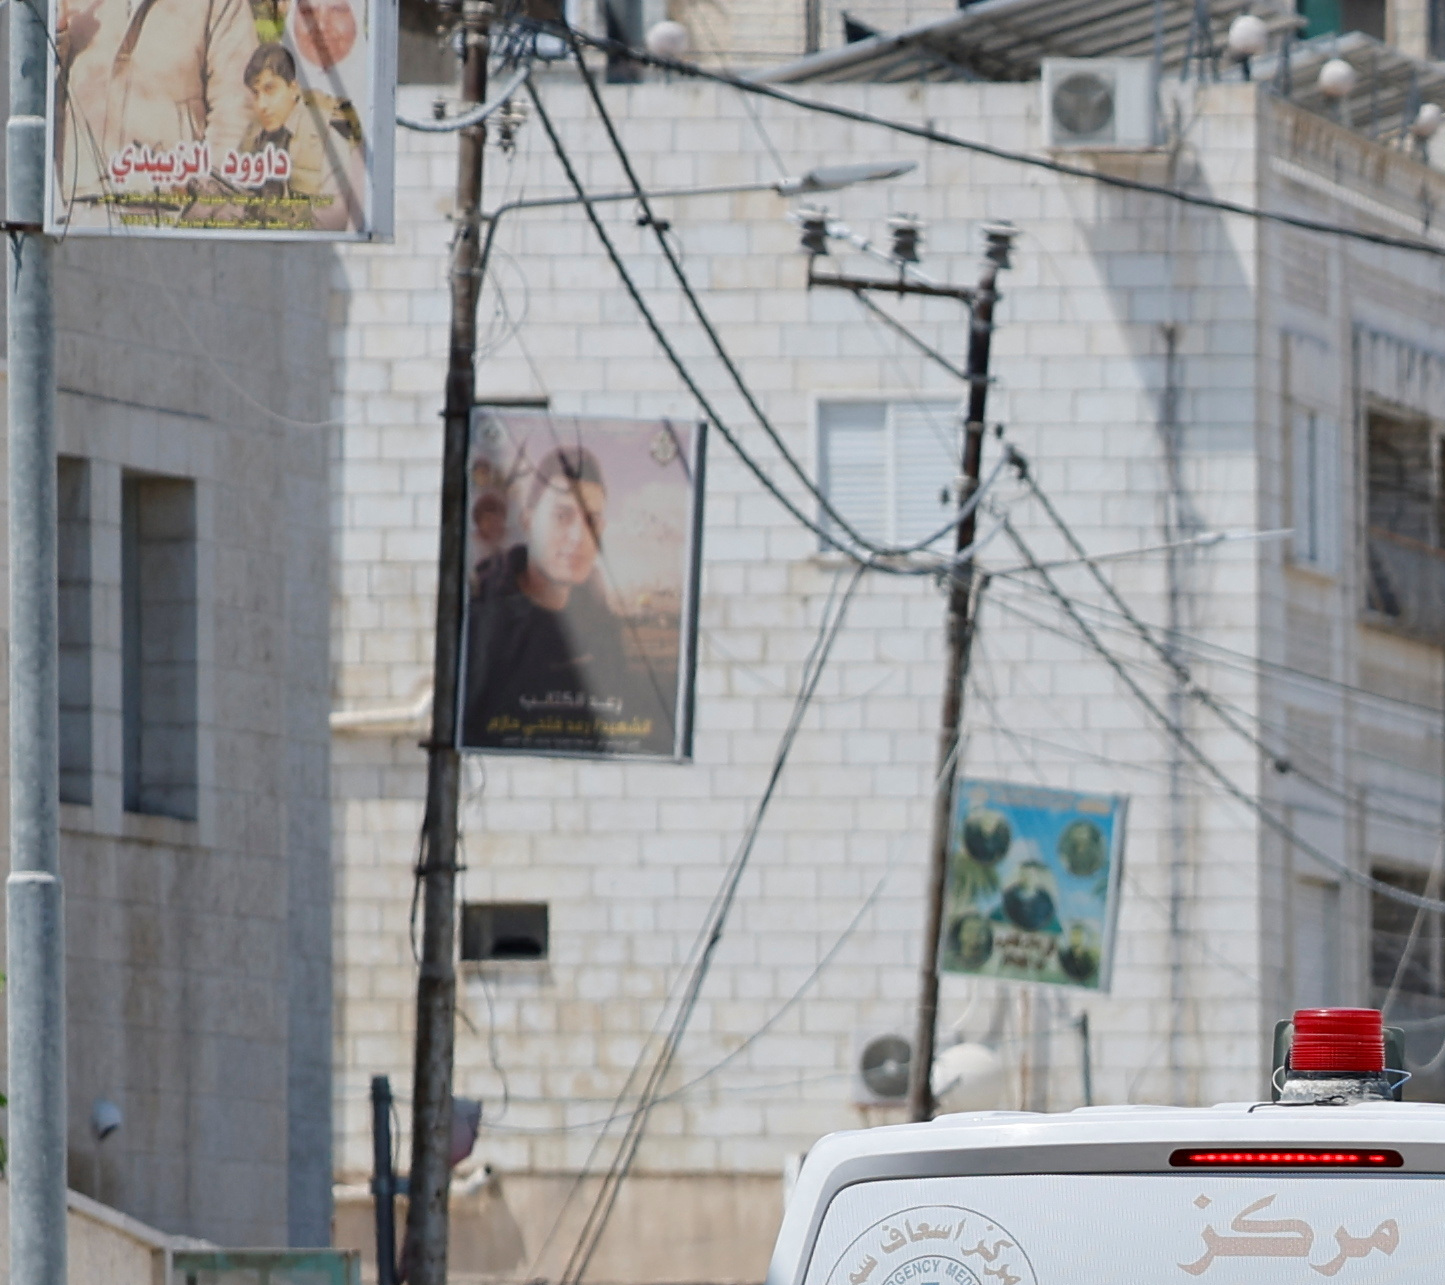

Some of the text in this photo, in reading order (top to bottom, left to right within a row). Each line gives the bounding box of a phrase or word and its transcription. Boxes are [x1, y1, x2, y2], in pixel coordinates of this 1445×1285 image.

[111, 145, 289, 182] داوود الزبيدي
[880, 1217, 967, 1254] اسعاف
[1176, 1194, 1400, 1277] مركز
